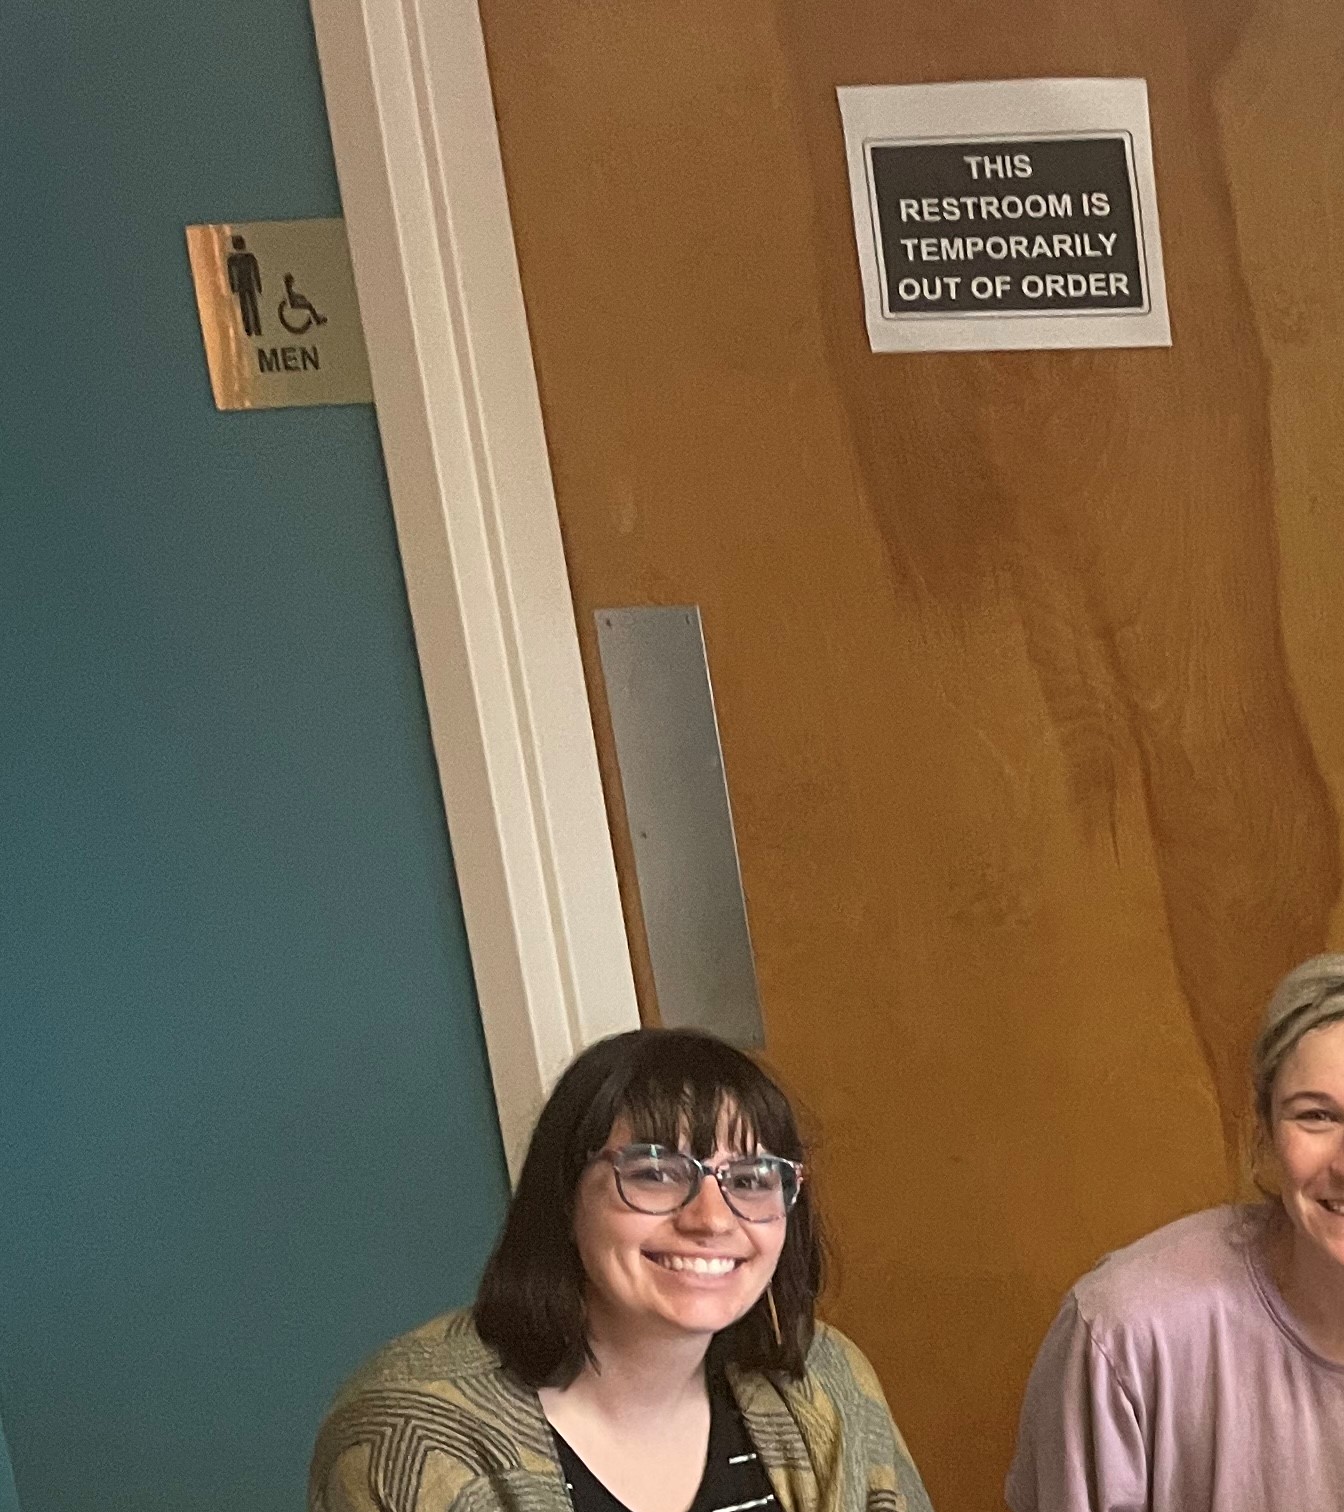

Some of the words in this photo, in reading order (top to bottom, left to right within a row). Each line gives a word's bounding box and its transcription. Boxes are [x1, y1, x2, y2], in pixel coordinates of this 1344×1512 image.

[963, 154, 1033, 180] THIS
[899, 194, 1073, 222] RESTROOM
[1082, 193, 1111, 217] IS
[900, 232, 1117, 261] TEMPORARILY
[898, 276, 962, 301] OUT
[971, 275, 1011, 299] OF
[1021, 272, 1130, 299] ORDER
[257, 346, 321, 373] MEN
